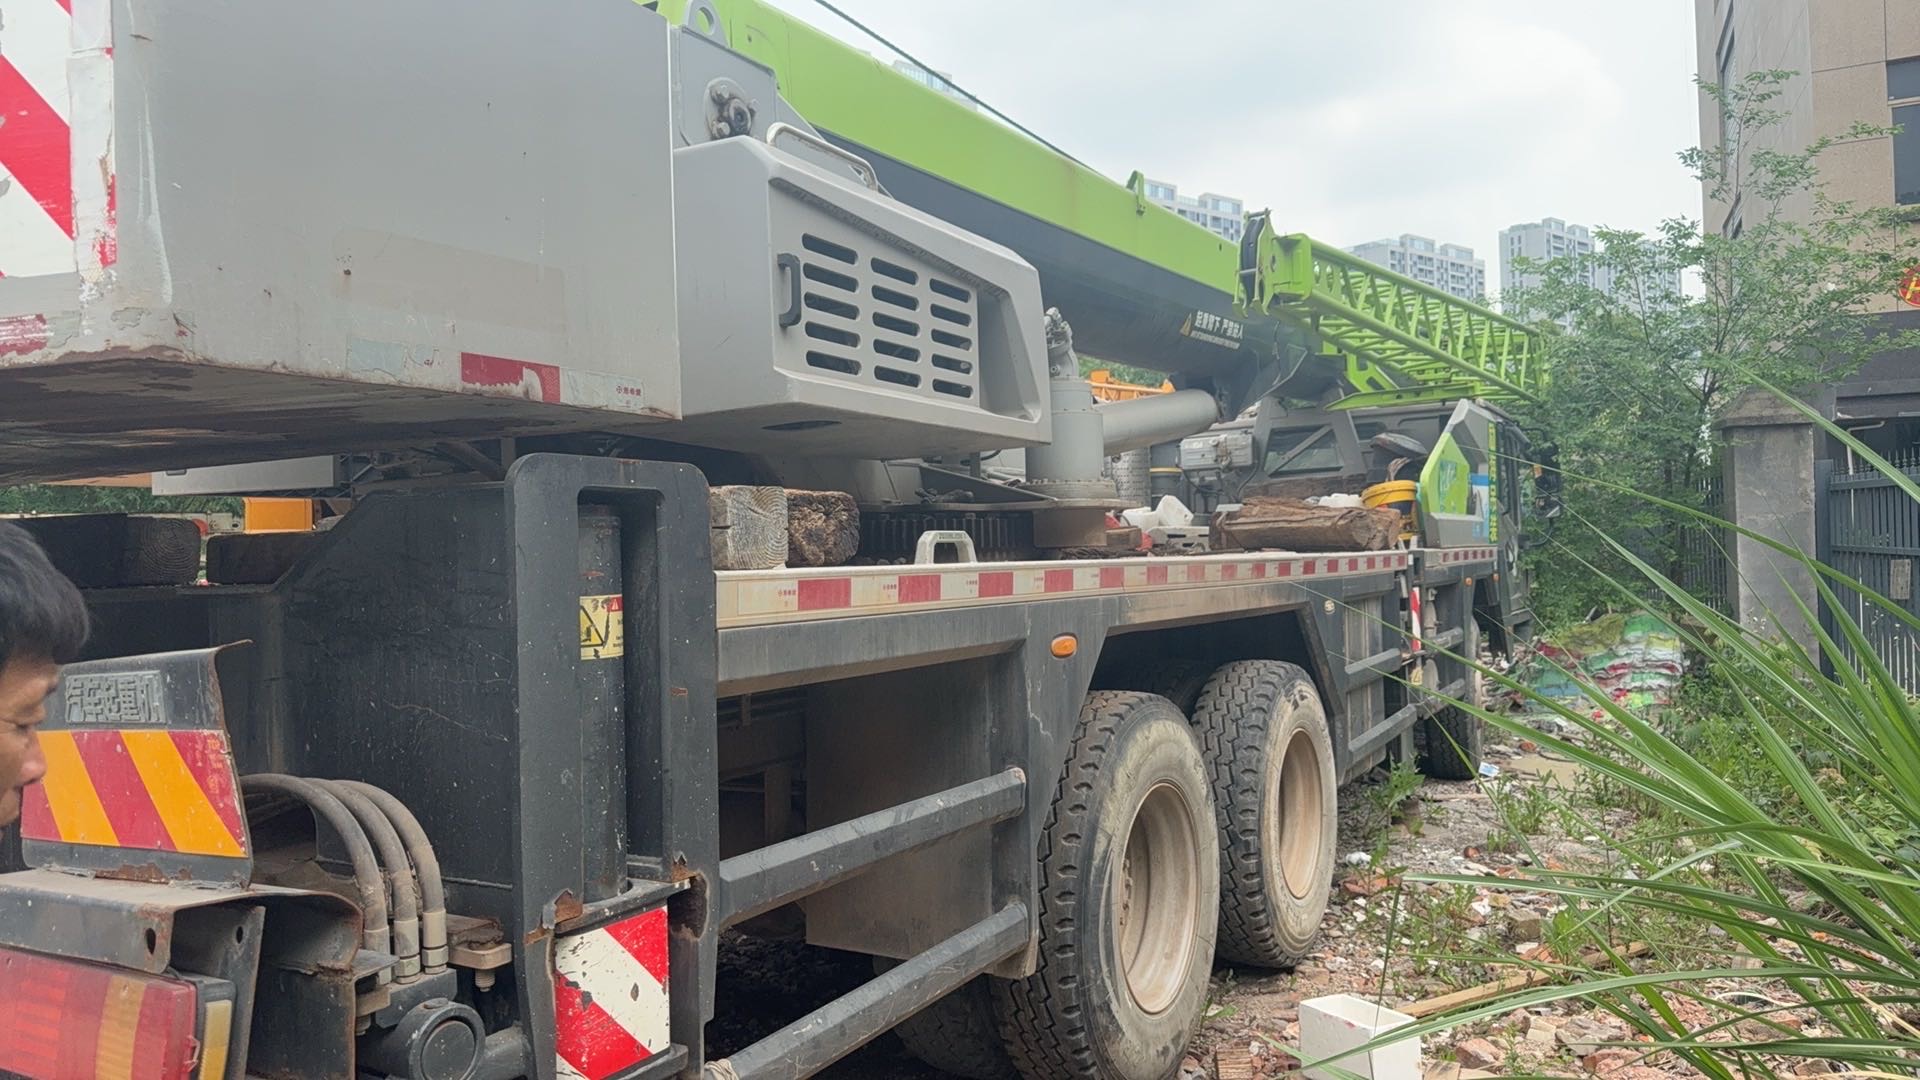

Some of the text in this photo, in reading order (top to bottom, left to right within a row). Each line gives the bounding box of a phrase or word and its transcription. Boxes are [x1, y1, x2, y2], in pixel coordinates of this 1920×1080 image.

[66, 674, 165, 723] 汽车起重机
